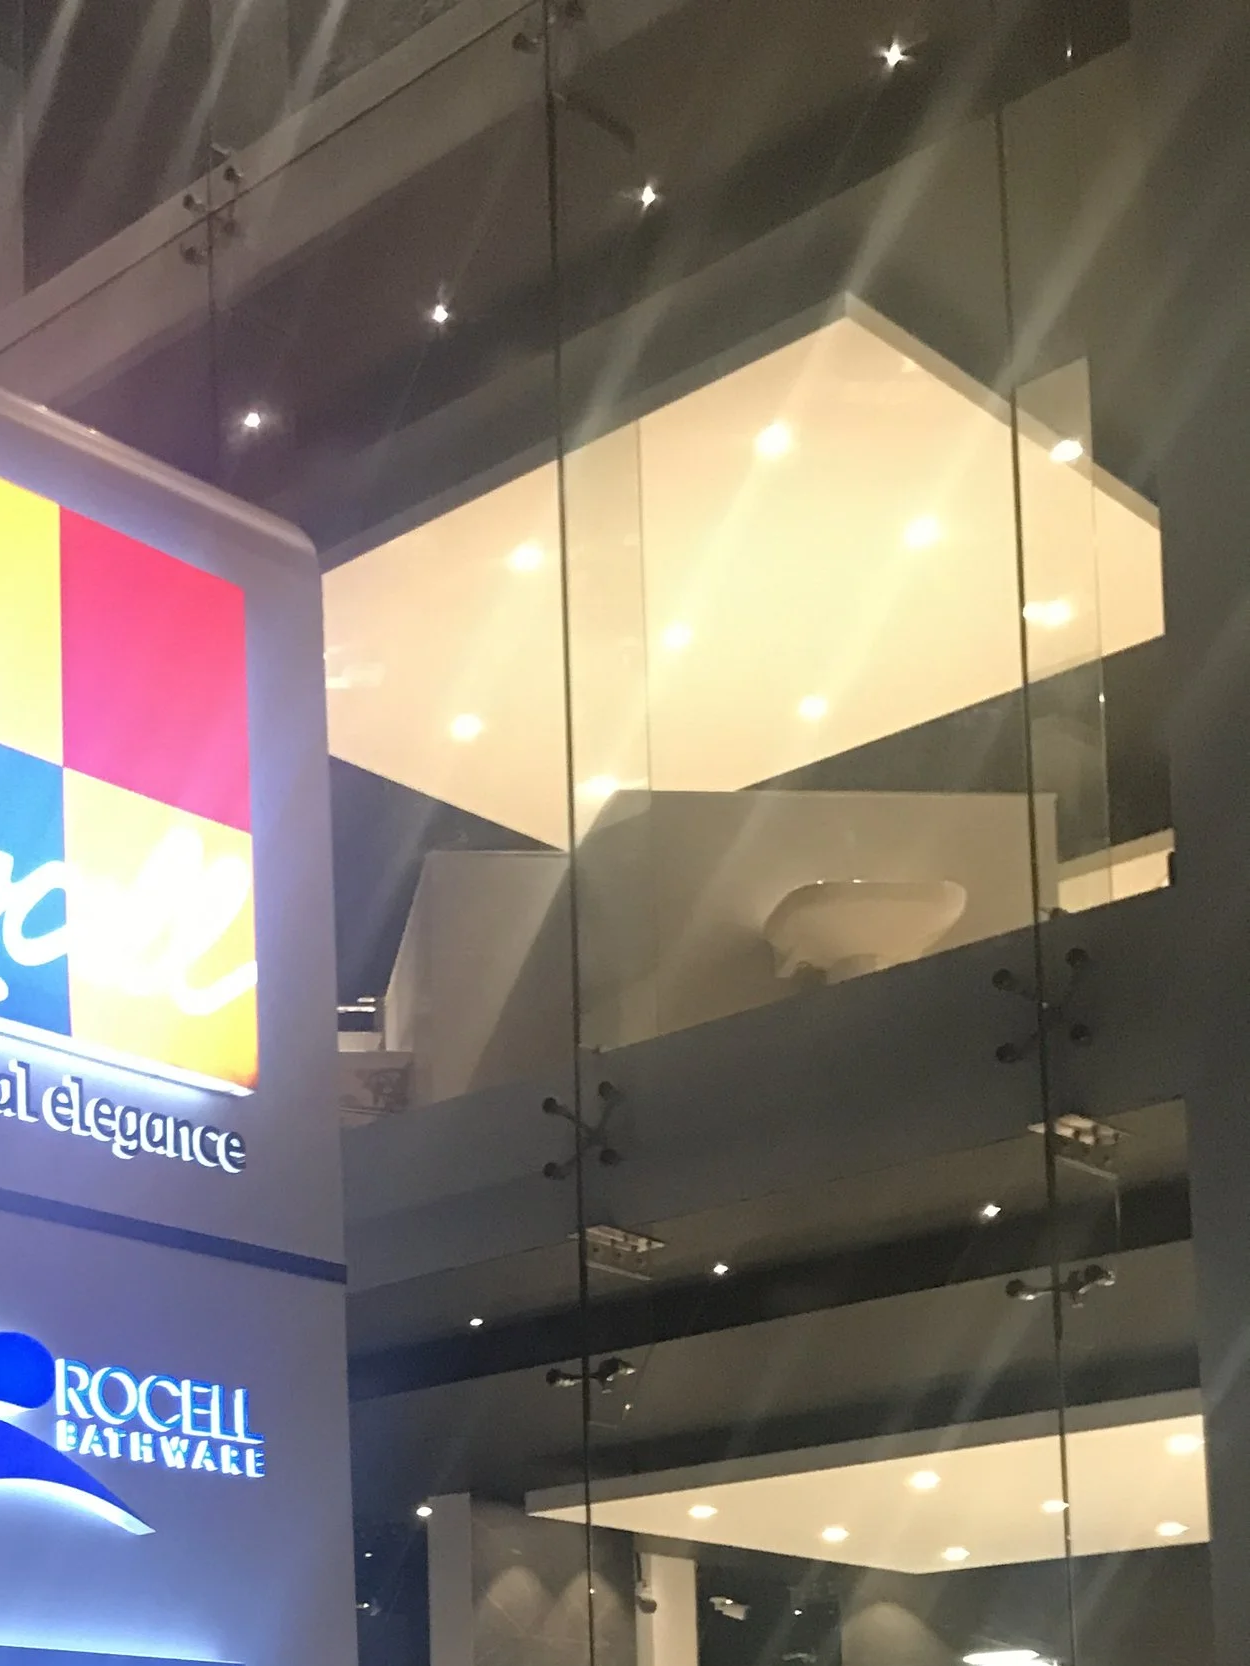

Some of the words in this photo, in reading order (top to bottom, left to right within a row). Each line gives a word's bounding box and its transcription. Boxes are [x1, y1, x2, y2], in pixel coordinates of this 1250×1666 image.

[42, 1074, 247, 1174] elegance
[54, 1357, 265, 1445] ROCELL
[55, 1419, 266, 1478] BATHWARE
